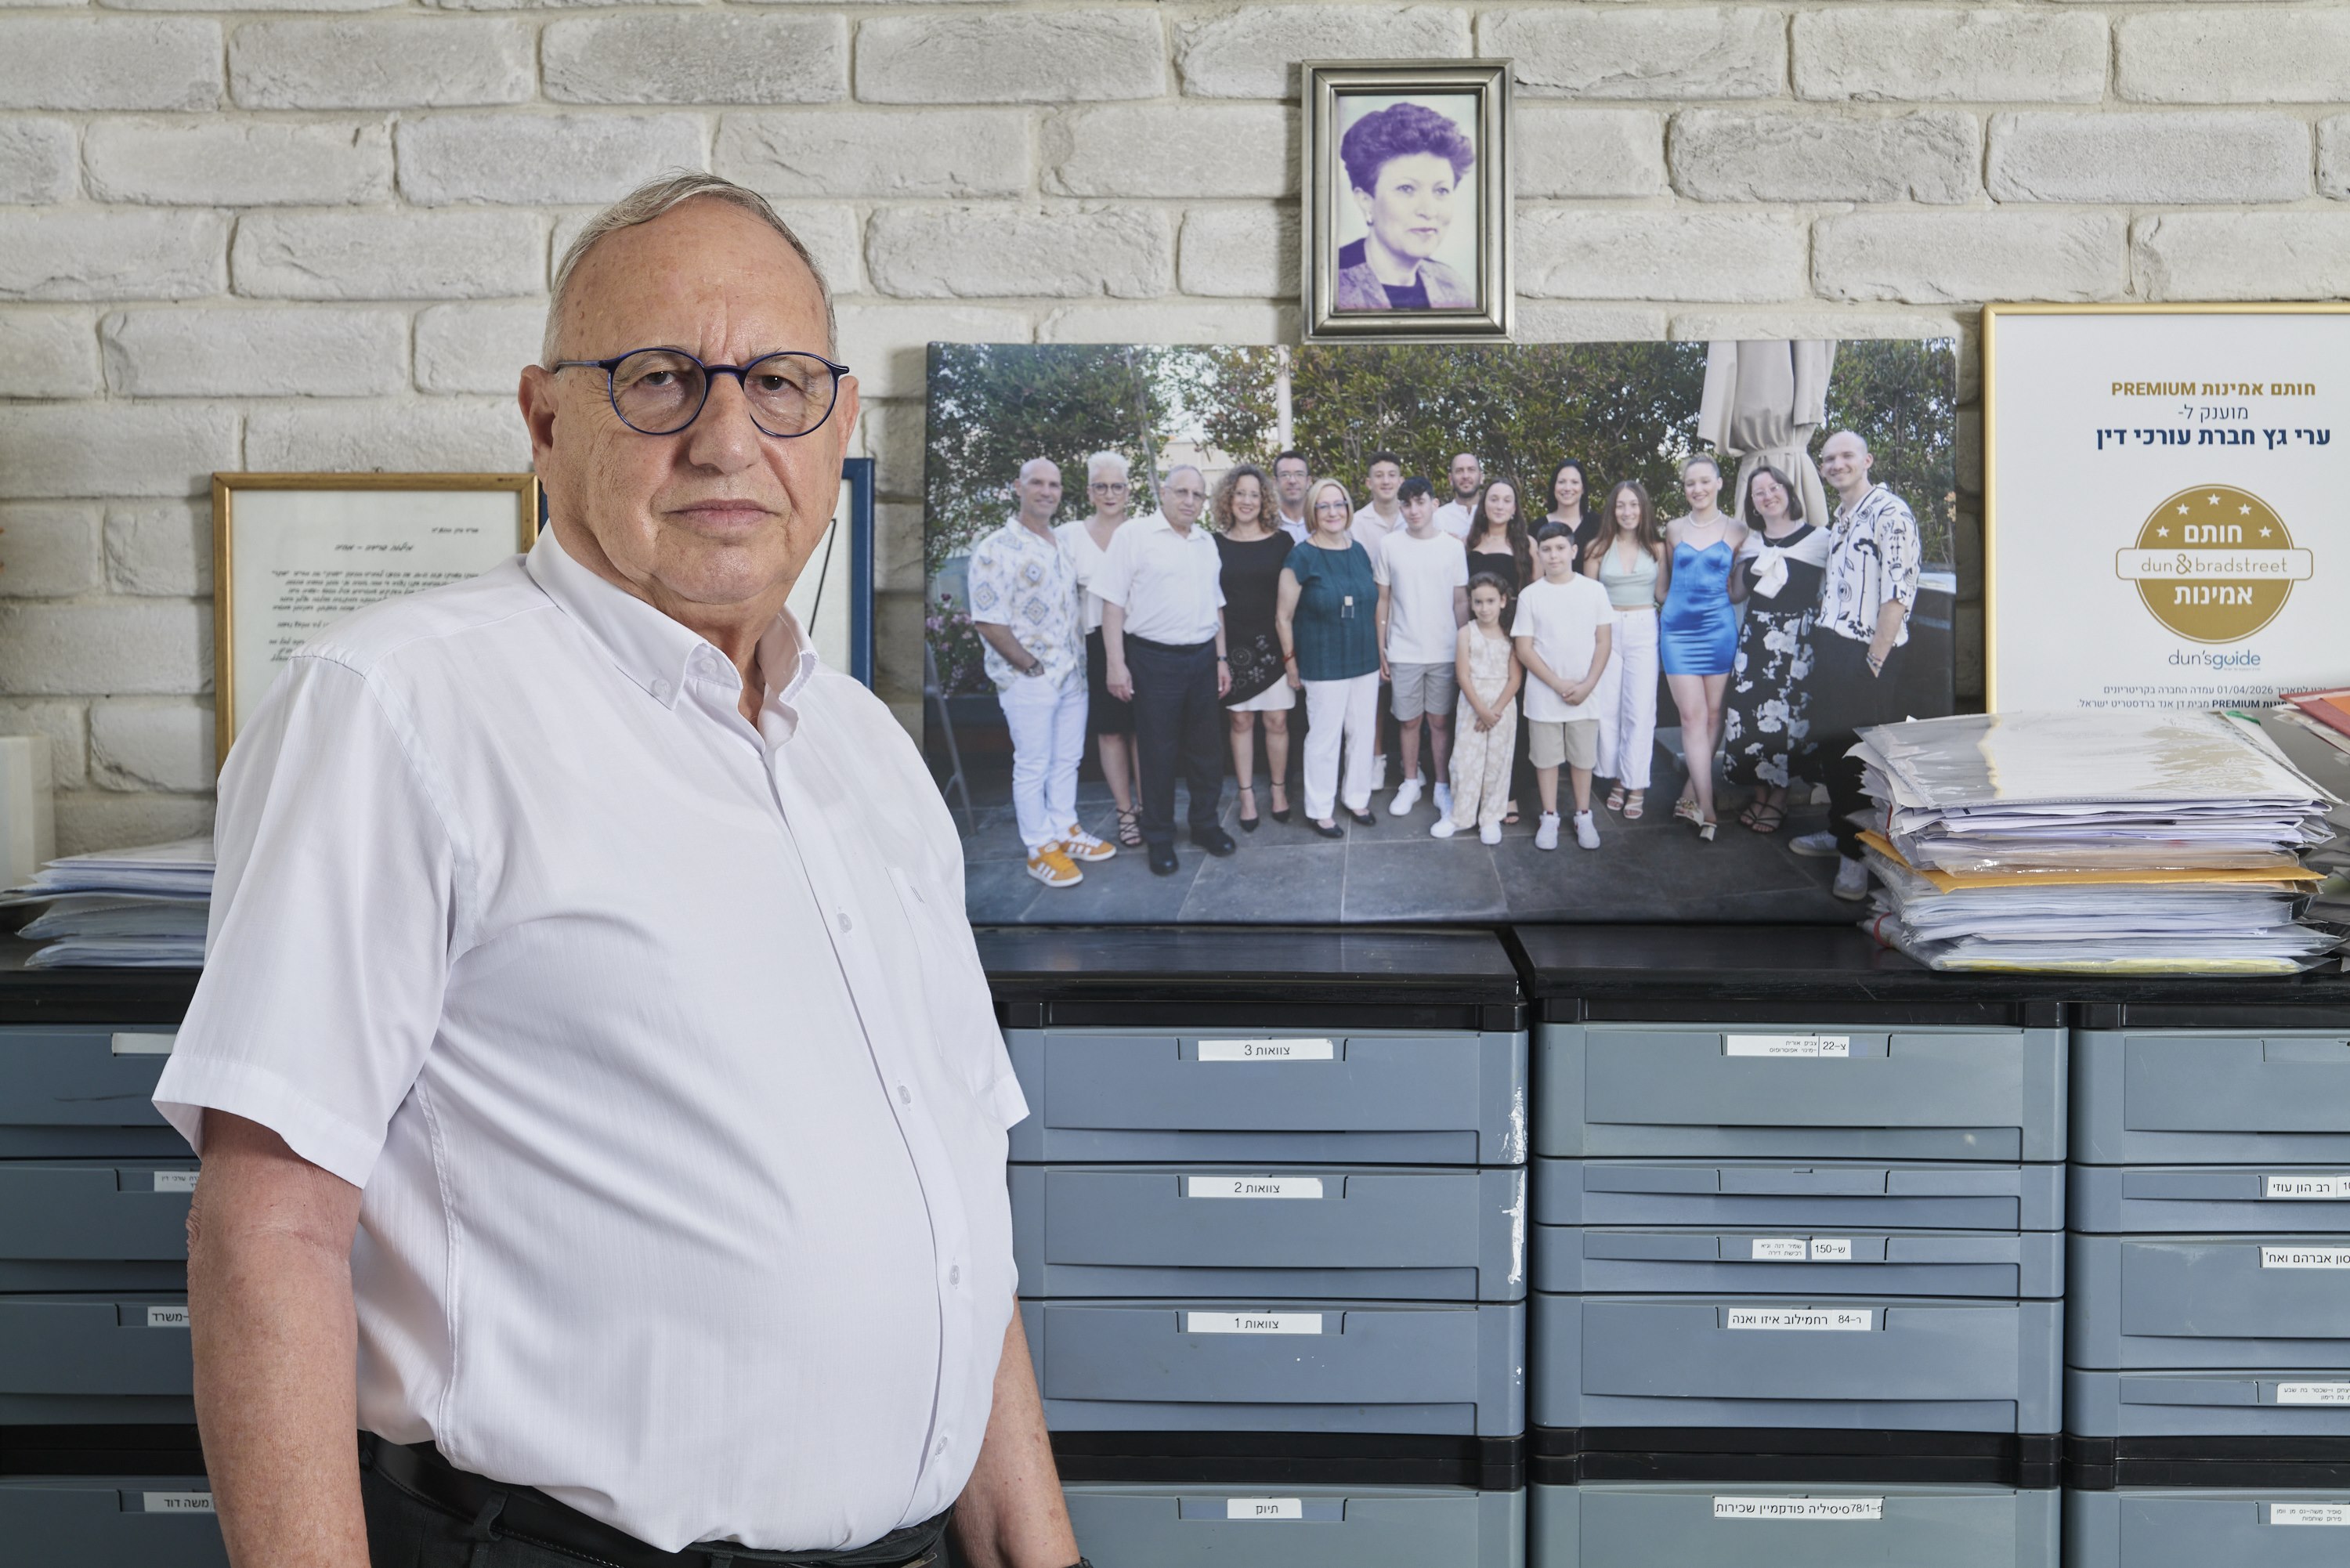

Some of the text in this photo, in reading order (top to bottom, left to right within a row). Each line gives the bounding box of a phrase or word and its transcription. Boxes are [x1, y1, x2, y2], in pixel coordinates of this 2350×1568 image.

[2111, 381, 2316, 396] חותם אמינות PREMIUM
[2178, 403, 2248, 424] מוענק ל-
[2096, 428, 2330, 450] ערי גץ חברת עורכי דין
[2184, 525, 2243, 544] חותם
[2174, 586, 2253, 605] אמינות
[2103, 686, 2156, 695] בקריטריונים
[2158, 686, 2188, 695] החברה
[2190, 686, 2214, 695] עמדה
[2217, 685, 2273, 695] 01/04/2026
[2177, 700, 2186, 710] דן
[2212, 699, 2260, 708] PREMIUM
[1244, 1044, 1290, 1057] צוואות 3
[1234, 1181, 1280, 1194] צוואות 2
[2272, 1183, 2330, 1194] רב הון עוזי
[1815, 1244, 1846, 1254] ש-150
[2293, 1255, 2332, 1263] אברהם
[1235, 1317, 1279, 1329] צוואות 1
[1732, 1313, 1828, 1325] רחמילוב איזו ואנה
[164, 1498, 209, 1508] משה דוד
[1255, 1505, 1278, 1516] תיוק
[1716, 1503, 1849, 1516] סיסיליה פודקמיין שכירות
